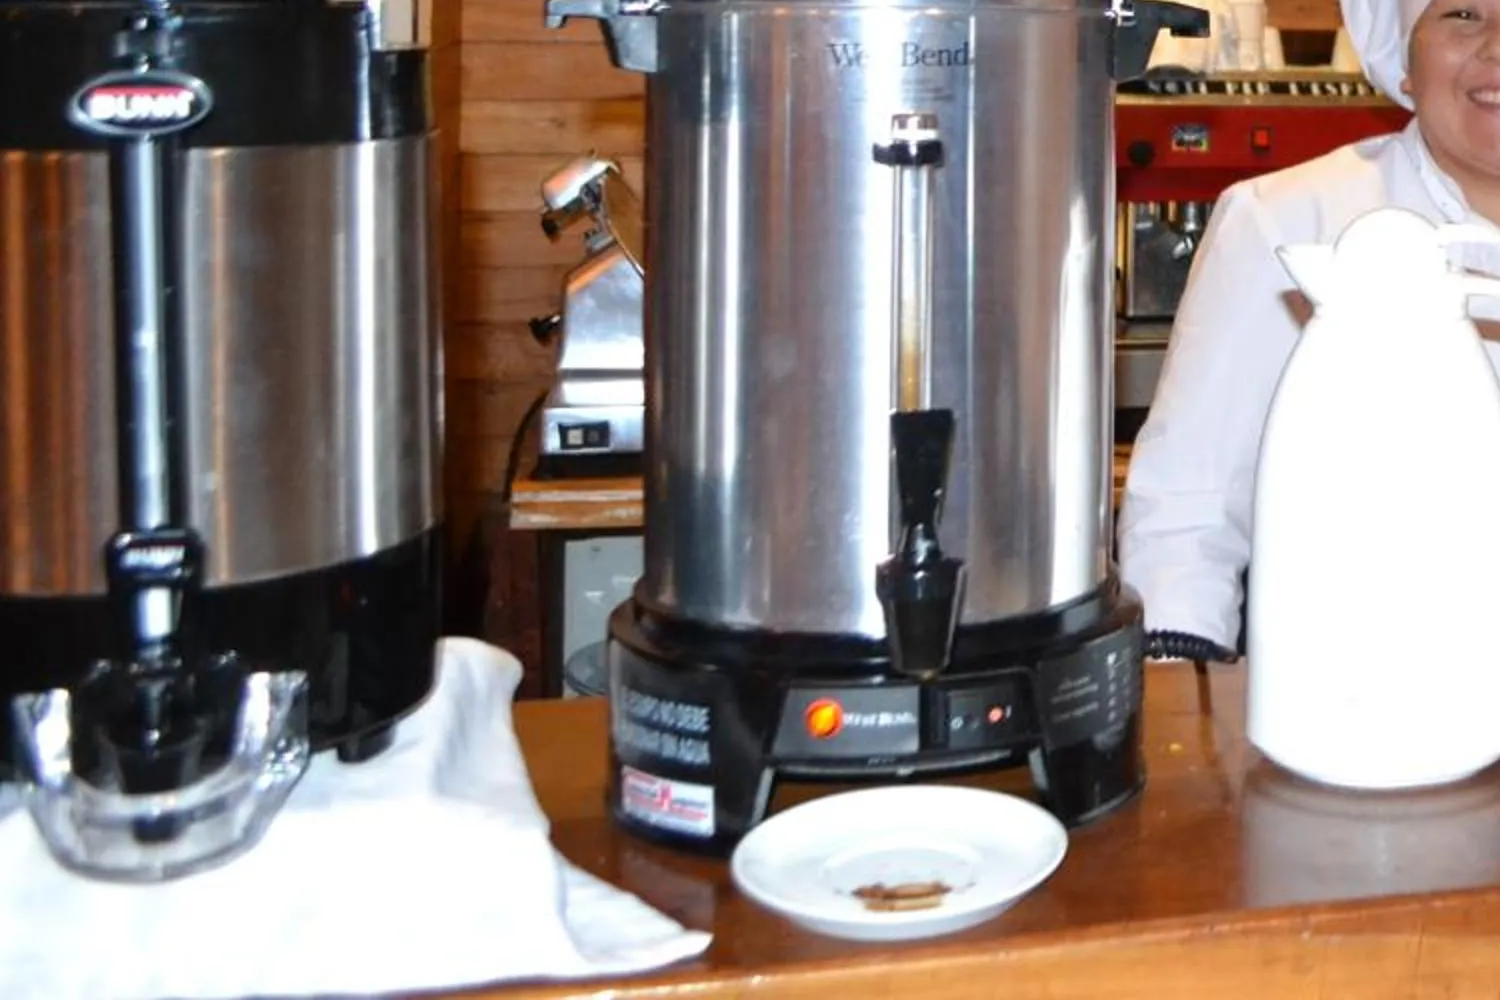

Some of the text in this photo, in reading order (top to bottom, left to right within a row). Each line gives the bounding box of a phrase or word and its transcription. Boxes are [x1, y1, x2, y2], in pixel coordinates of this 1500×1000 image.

[826, 41, 970, 68] We Bend
[88, 91, 193, 120] BUNN
